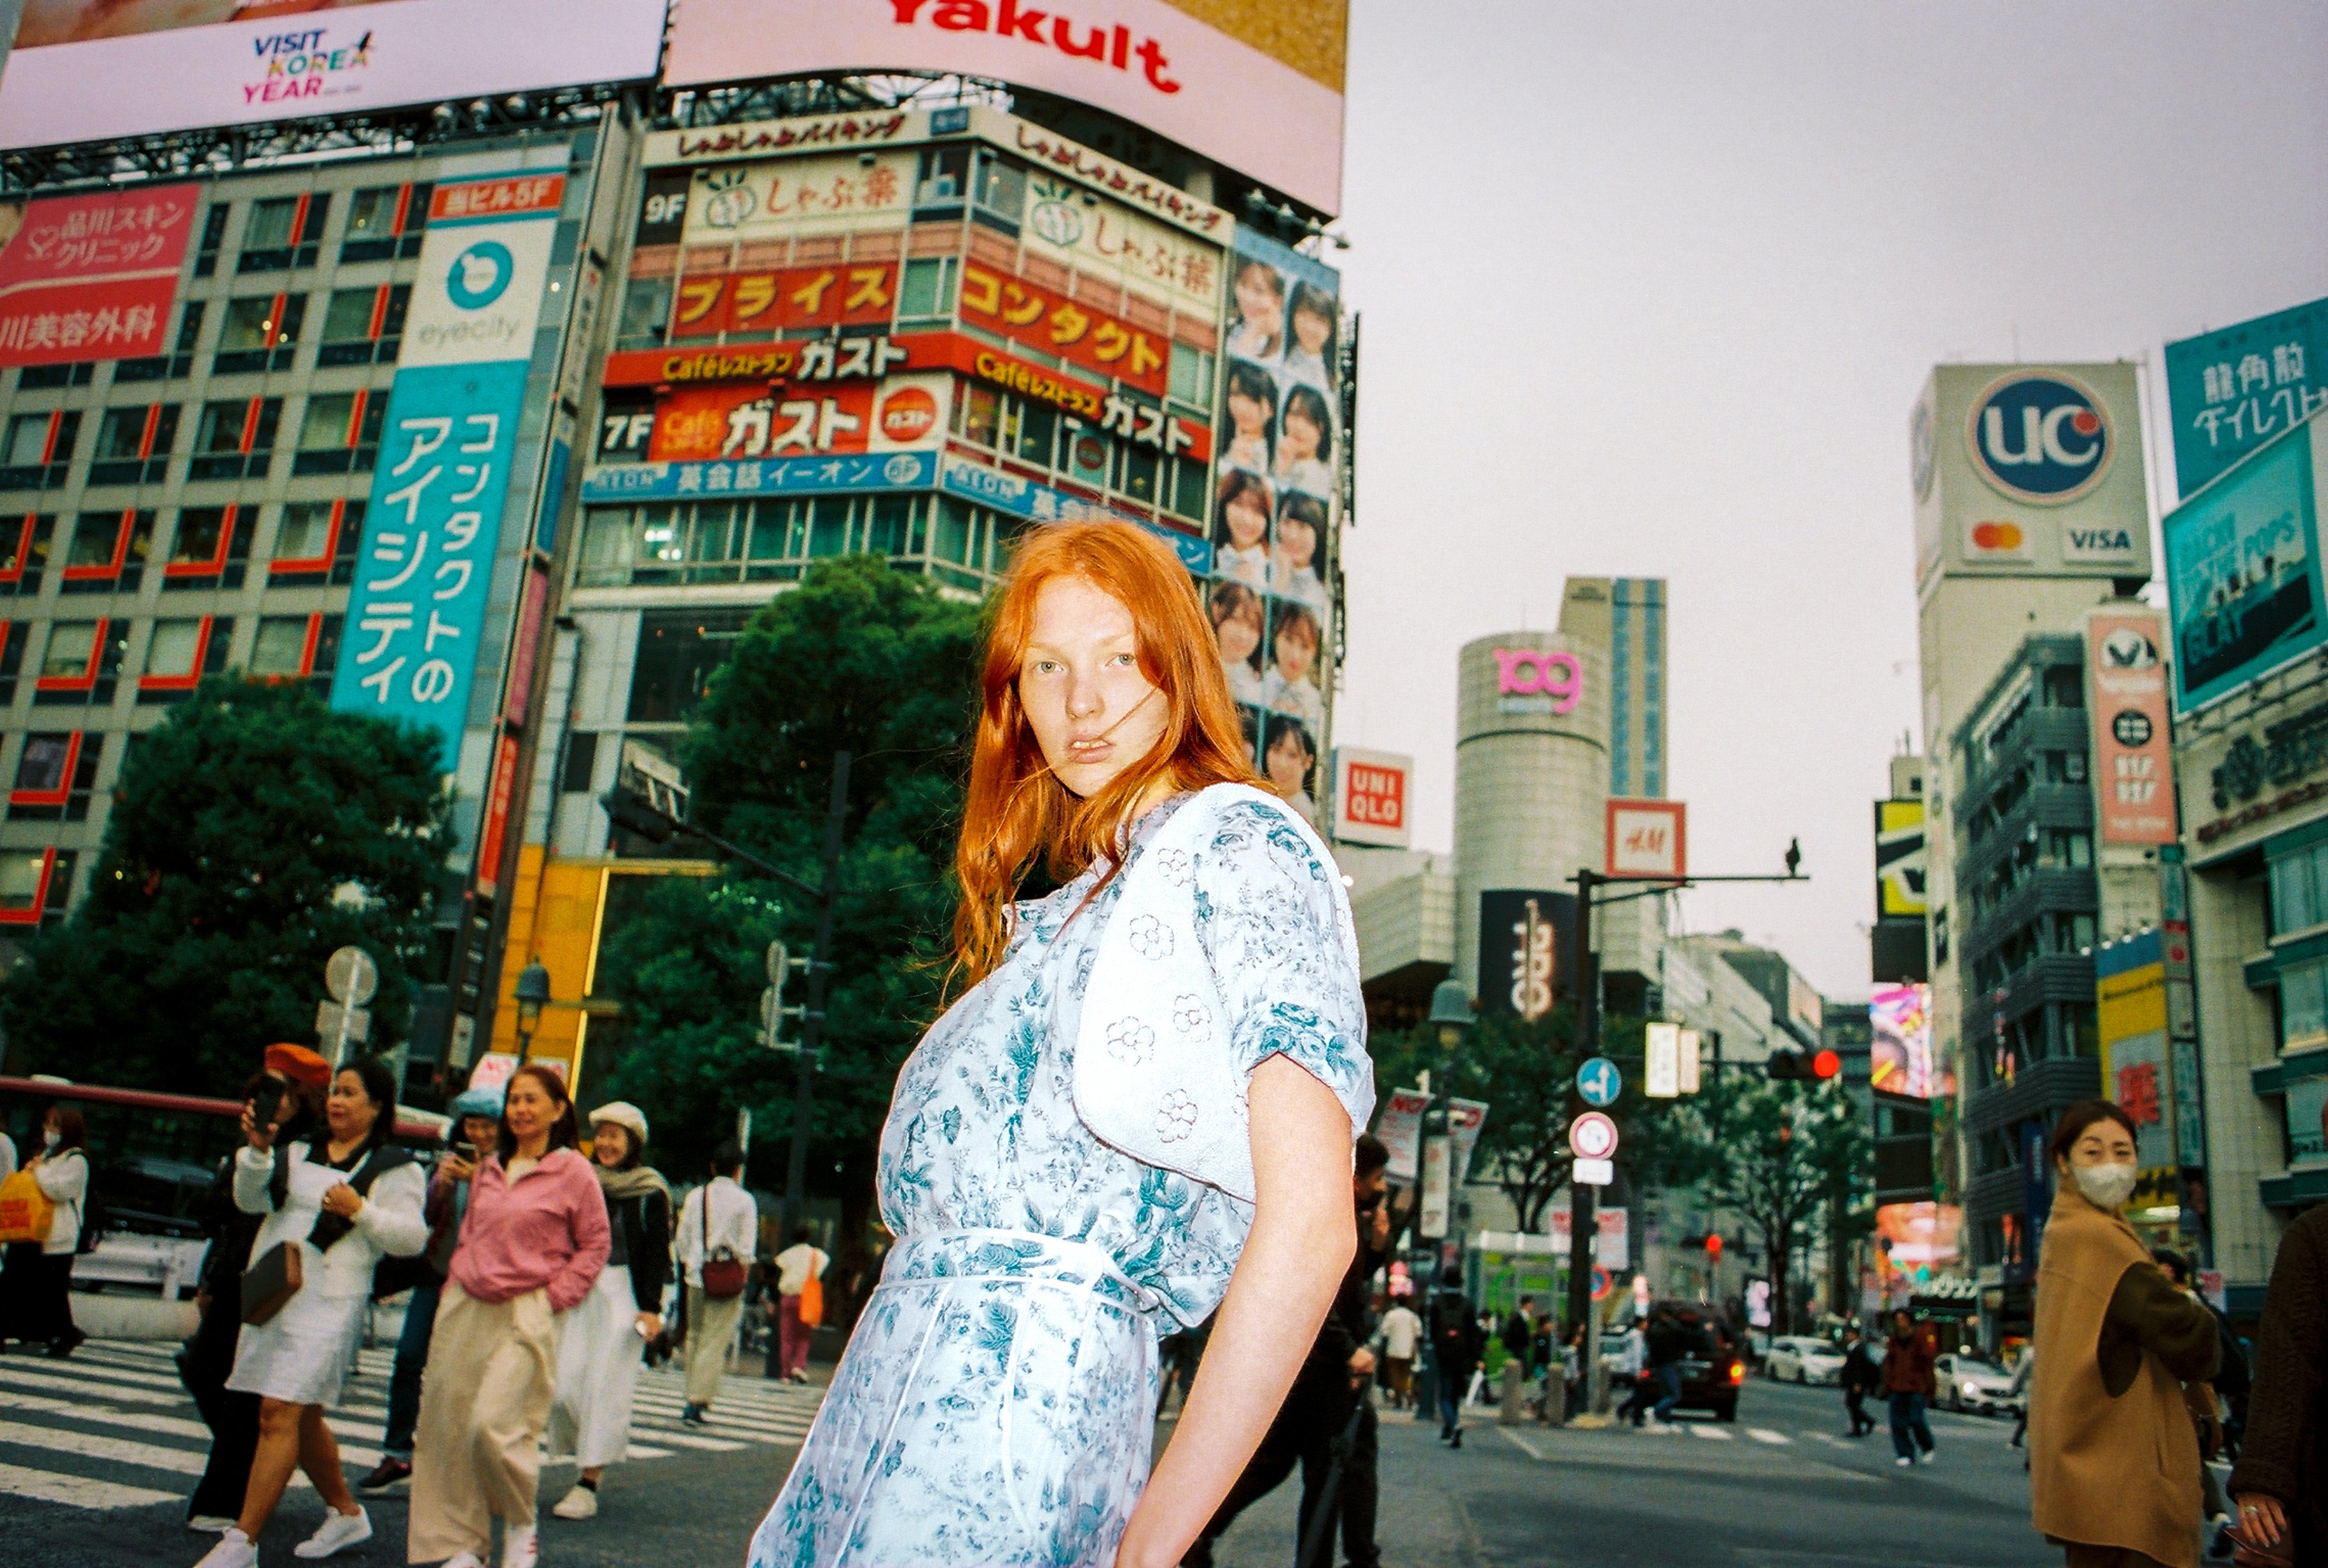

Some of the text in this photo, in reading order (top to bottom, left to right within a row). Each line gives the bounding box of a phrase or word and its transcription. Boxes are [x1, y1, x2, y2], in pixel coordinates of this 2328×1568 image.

[254, 29, 326, 57] VISIT
[268, 47, 369, 78] KOREA
[244, 77, 323, 103] YEAR
[61, 202, 186, 239] 品川スキン
[646, 193, 687, 224] 9F
[53, 233, 165, 269] クリニック
[962, 266, 1162, 376] コンタクト
[797, 336, 907, 381] ガスト
[605, 413, 654, 450] 7F
[721, 398, 861, 457] ガスト
[1101, 394, 1194, 454] ガスト
[2070, 528, 2131, 551] VISA
[356, 417, 452, 704] アイシティ
[411, 414, 499, 703] コンタクトの
[1493, 648, 1582, 715] 109
[1352, 769, 1396, 795] UNI
[1351, 795, 1400, 821] QLO
